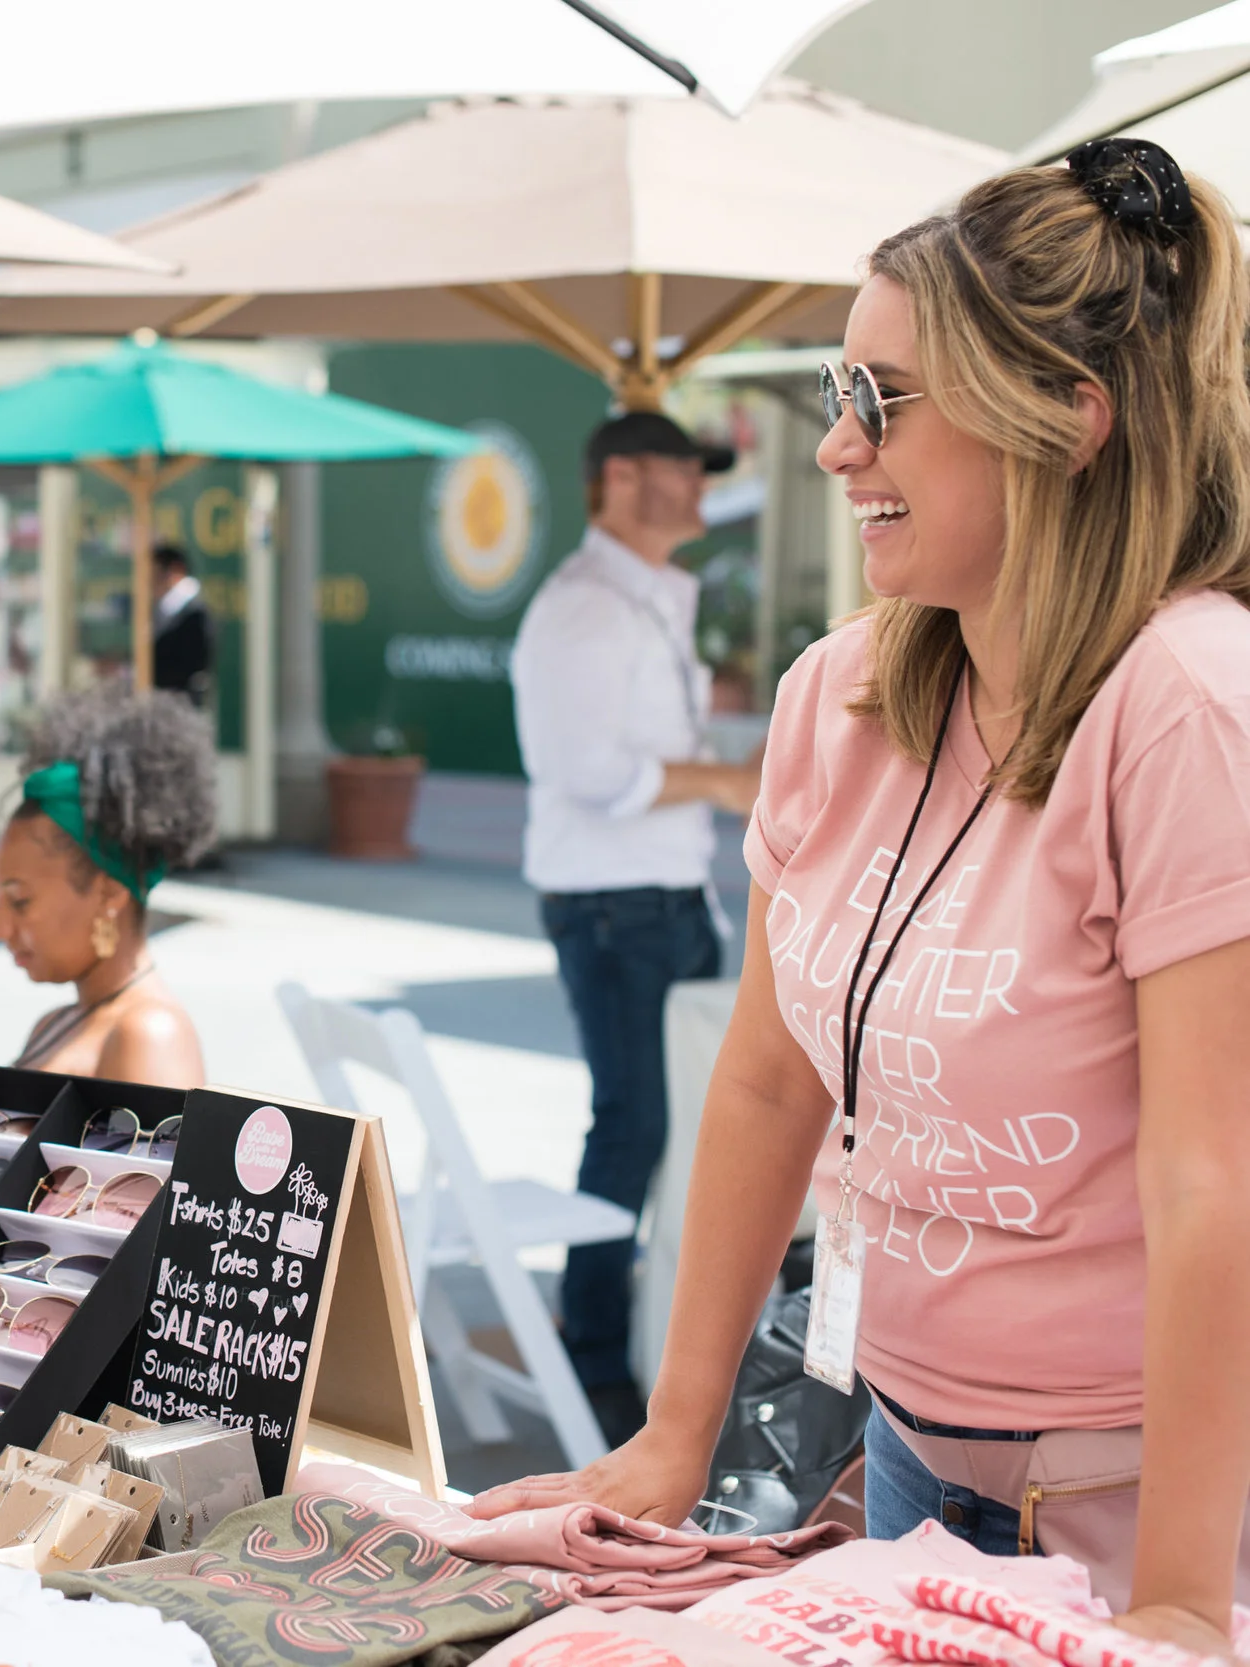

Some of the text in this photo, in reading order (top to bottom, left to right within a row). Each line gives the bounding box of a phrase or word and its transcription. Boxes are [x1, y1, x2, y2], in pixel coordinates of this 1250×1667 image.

[238, 1143, 287, 1170] Dream
[246, 1121, 286, 1148] Babe
[170, 1180, 275, 1242] T-shirts $25
[156, 1257, 238, 1309] Kids $10
[210, 1241, 303, 1288] Totes $8
[147, 1300, 216, 1355] SALE
[131, 1378, 162, 1423] Buy
[219, 1404, 254, 1431] Free
